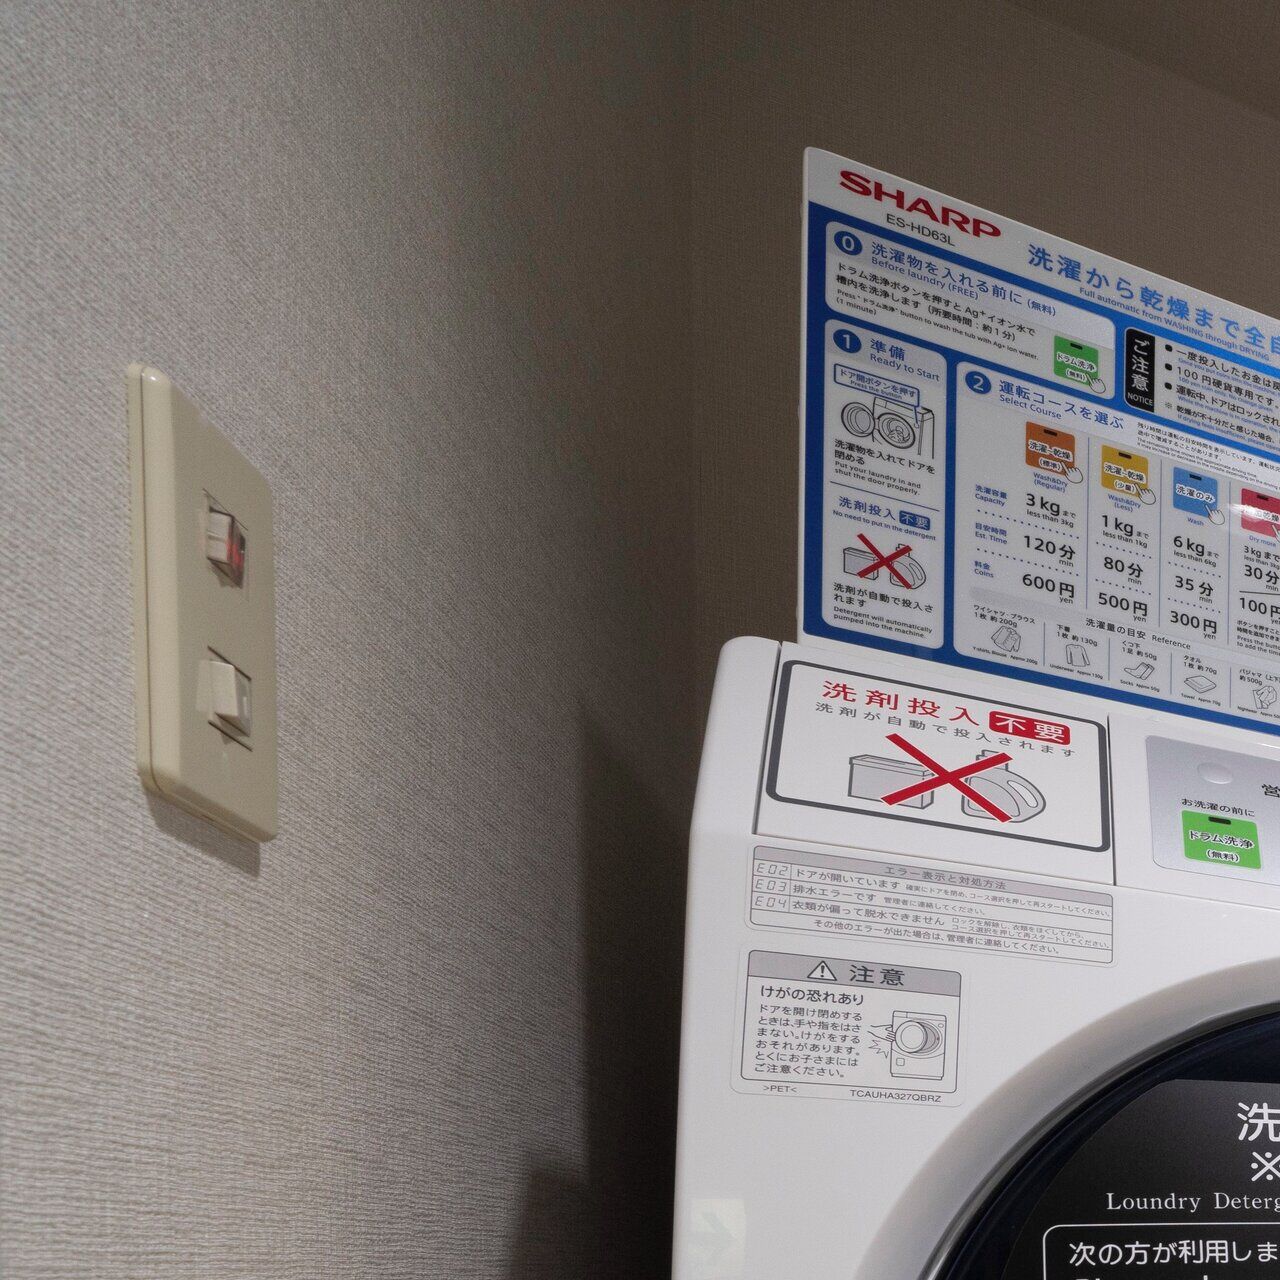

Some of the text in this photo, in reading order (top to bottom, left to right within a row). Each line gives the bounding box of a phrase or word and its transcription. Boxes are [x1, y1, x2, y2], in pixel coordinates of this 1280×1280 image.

[839, 170, 1001, 240] SHARP
[886, 213, 955, 247] ES-HD63L
[871, 241, 1022, 306] 洗濯物を入れる前に
[871, 256, 979, 300] Before laundry (FREE)
[1079, 288, 1095, 298] Full
[1098, 295, 1140, 314] automatic
[1164, 317, 1204, 337] WASHING
[1205, 332, 1238, 349] through
[1239, 344, 1269, 361] DRYING
[870, 338, 906, 361] 準備
[869, 352, 940, 382] Ready to Start
[998, 379, 1124, 430] 運転コースを選ぶ
[999, 394, 1062, 420] Select Course
[1127, 391, 1154, 407] NOTICE
[975, 493, 1006, 507] Capacity
[1176, 484, 1214, 503] 洗濯のみ
[838, 495, 896, 521] 洗剤投入
[1187, 516, 1204, 526] Wash
[1152, 634, 1191, 650] Reference
[822, 679, 1067, 743] 洗剤投入 不要
[815, 700, 1076, 758] 洗剤が自動で投入されます
[1181, 798, 1255, 817] お洗濯の前に
[1188, 830, 1254, 849] ドラム洗浄
[794, 868, 900, 890] ドアが開いています
[885, 865, 1007, 891] エラー表示と対処方法
[793, 884, 877, 903] 排水エラーです
[792, 901, 945, 926] 衣類が偏って脱水できません
[850, 964, 905, 986] 注意
[761, 985, 864, 1005] けがの恐れあり
[760, 1004, 863, 1021] ドアを開け閉めする
[758, 1016, 861, 1032] ときは、手や指をはさ
[757, 1028, 860, 1044] まない。けがをする
[755, 1040, 860, 1056] おそれがあります。
[755, 1052, 858, 1067] とくにお子さまには
[755, 1063, 845, 1078] ご注意ください。
[1106, 1192, 1201, 1212] Loundry
